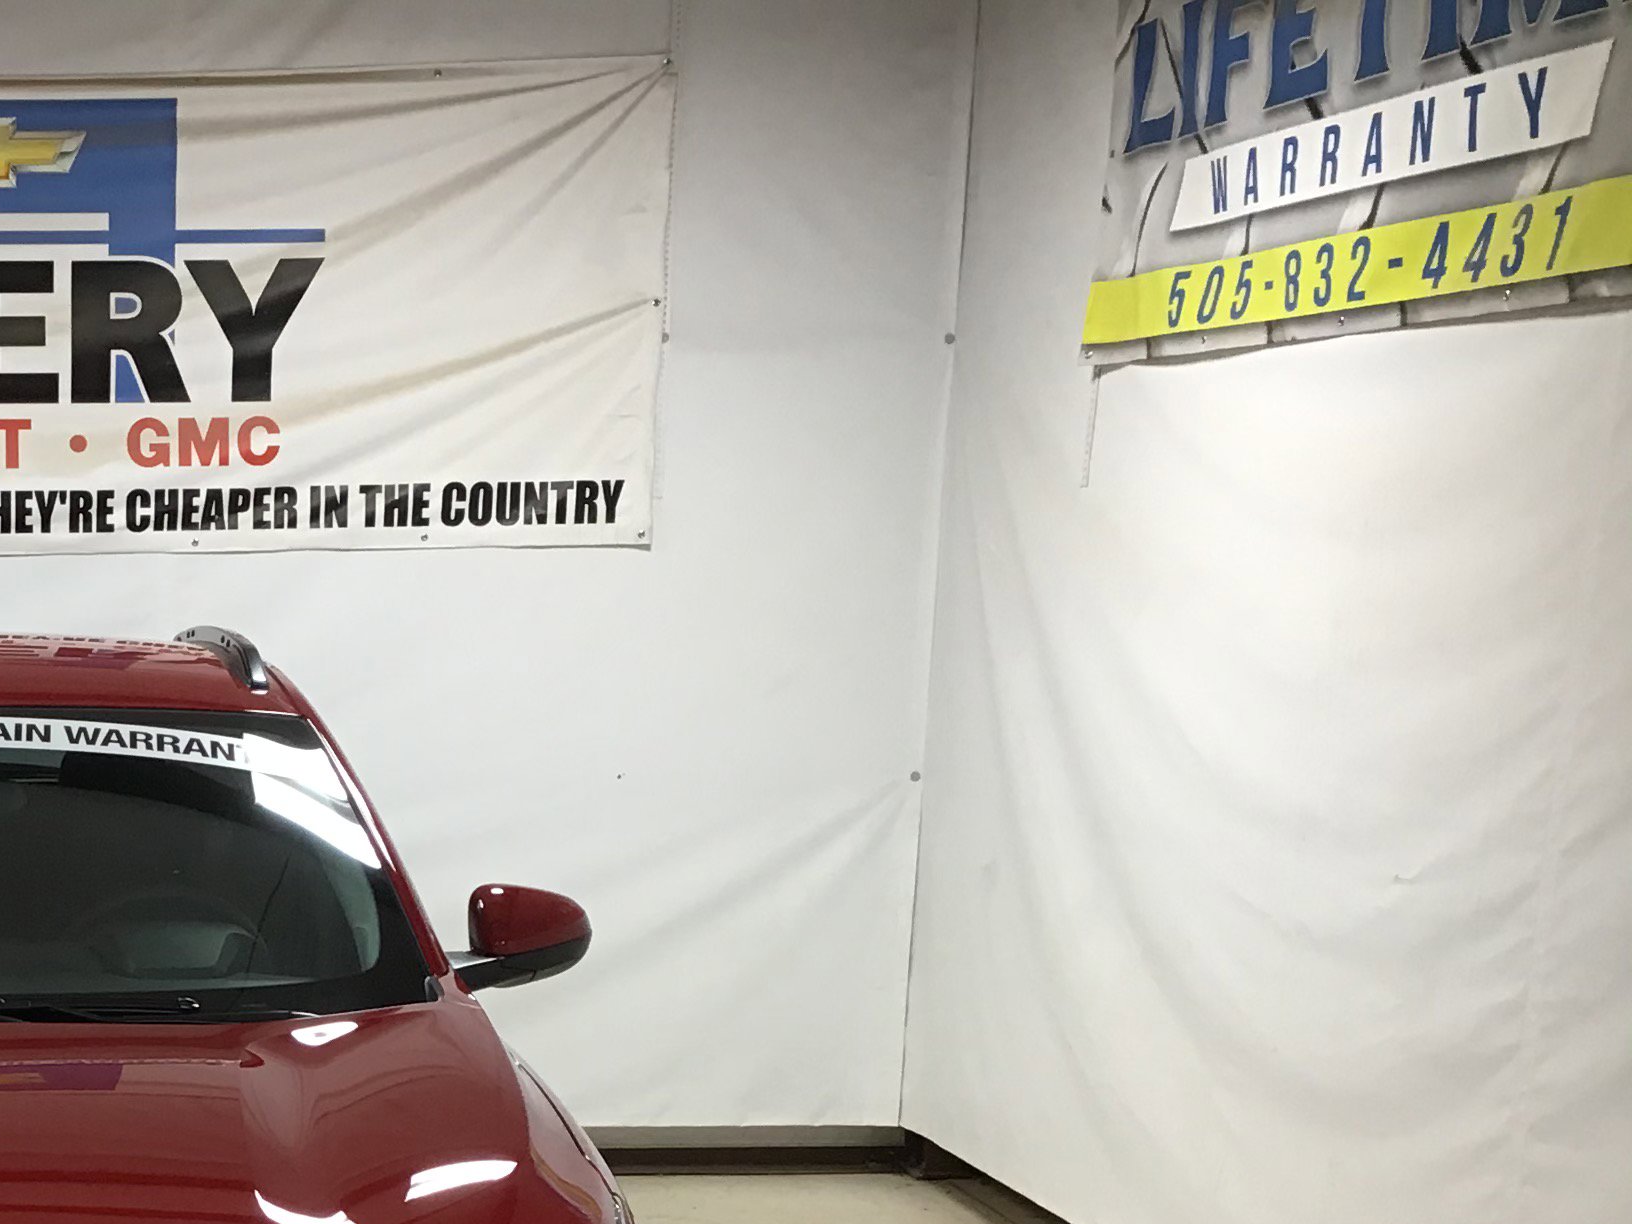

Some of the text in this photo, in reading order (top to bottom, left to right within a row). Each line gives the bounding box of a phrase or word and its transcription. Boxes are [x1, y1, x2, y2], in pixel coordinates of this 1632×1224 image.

[1122, 0, 1609, 155] LIFE
[1210, 66, 1549, 214] WARRANTY
[1167, 196, 1574, 329] 505-832-4431
[126, 416, 281, 467] GMC
[125, 486, 298, 534] CHEAPER
[310, 485, 350, 529] IN
[358, 483, 430, 528] THE
[441, 480, 626, 528] COUNTRY
[65, 726, 250, 763] WARRAN
